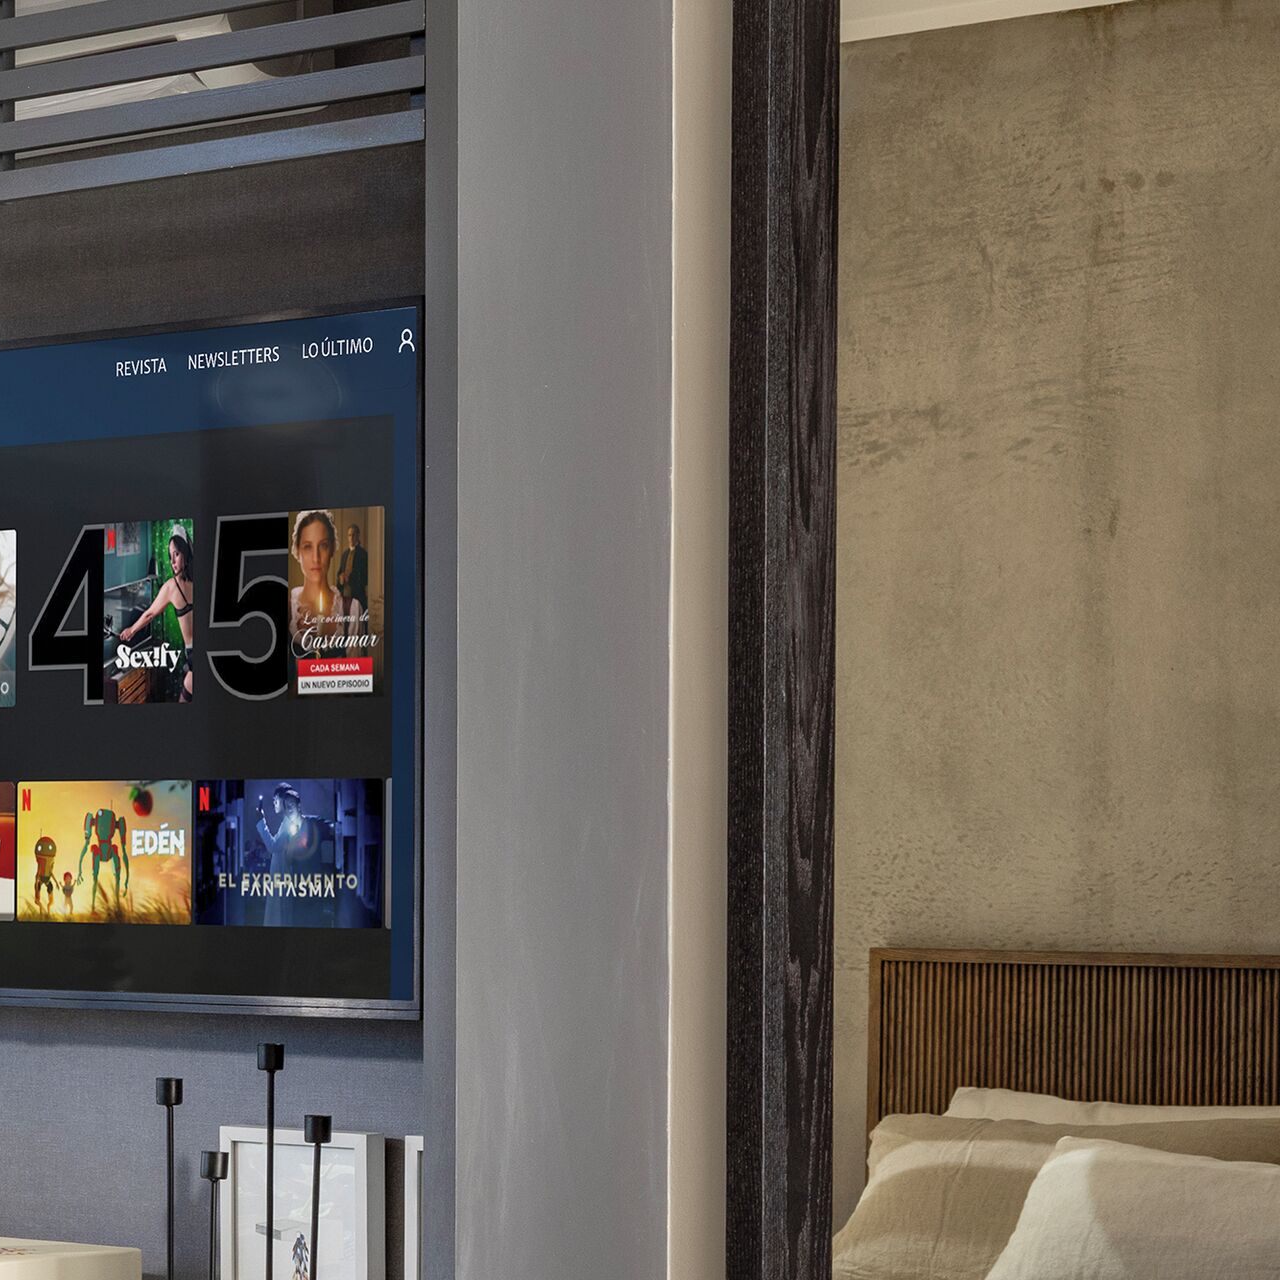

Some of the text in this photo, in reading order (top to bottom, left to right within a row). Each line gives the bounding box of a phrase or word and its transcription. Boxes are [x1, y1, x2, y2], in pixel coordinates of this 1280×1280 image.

[188, 347, 280, 370] NEWSLETTERS
[302, 337, 373, 359] LO ÚLTIMO
[116, 358, 167, 377] REVISTA
[29, 524, 104, 705] 4
[207, 512, 288, 700] 5
[291, 626, 380, 658] Castamar
[310, 663, 360, 673] CADA SEMANA
[301, 679, 370, 689] UN NUEVO EPISODIO
[131, 823, 185, 857] EDÉN
[218, 873, 358, 889] EL EXPERIMENTO
